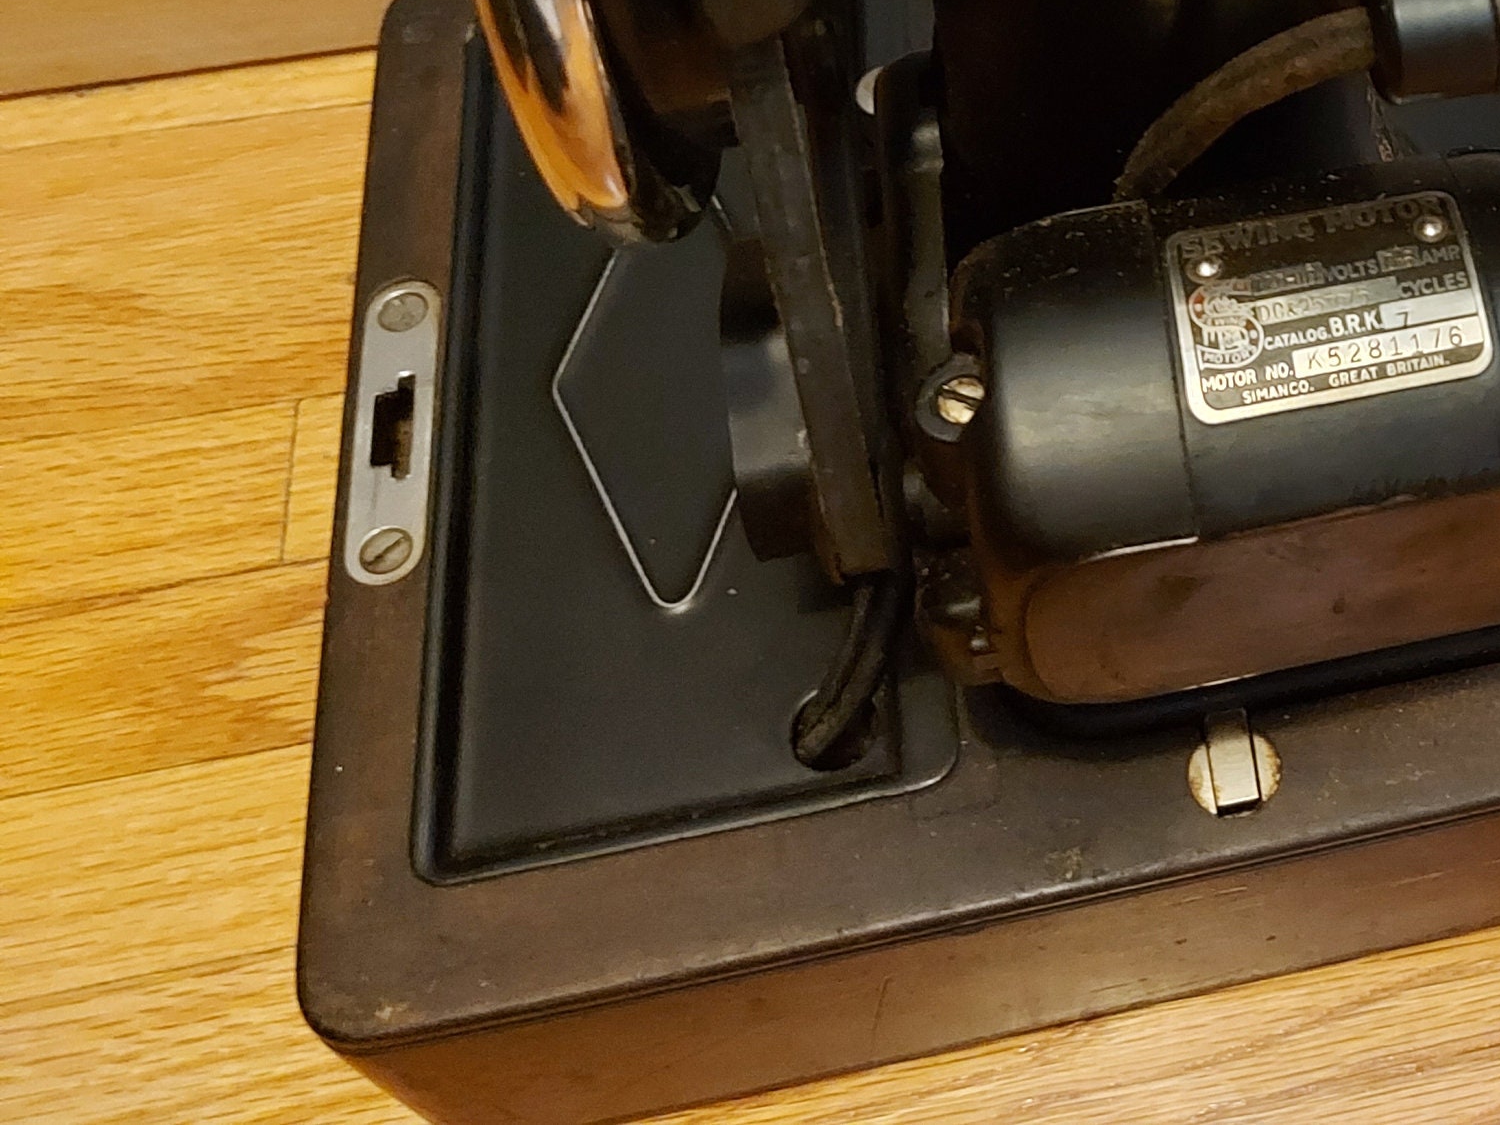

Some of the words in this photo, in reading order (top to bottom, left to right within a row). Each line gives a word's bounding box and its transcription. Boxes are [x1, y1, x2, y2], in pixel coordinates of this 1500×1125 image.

[1181, 215, 1316, 257] SEWING
[1325, 259, 1379, 284] VOLTS
[1400, 271, 1468, 298] CYCLES
[1202, 368, 1257, 392] MOTOR
[1265, 362, 1294, 381] NO.
[1307, 325, 1463, 370] K5281176
[1242, 380, 1315, 404] SIMANCO.
[1328, 366, 1378, 387] GREAT
[1386, 353, 1450, 376] BRITAIN.
